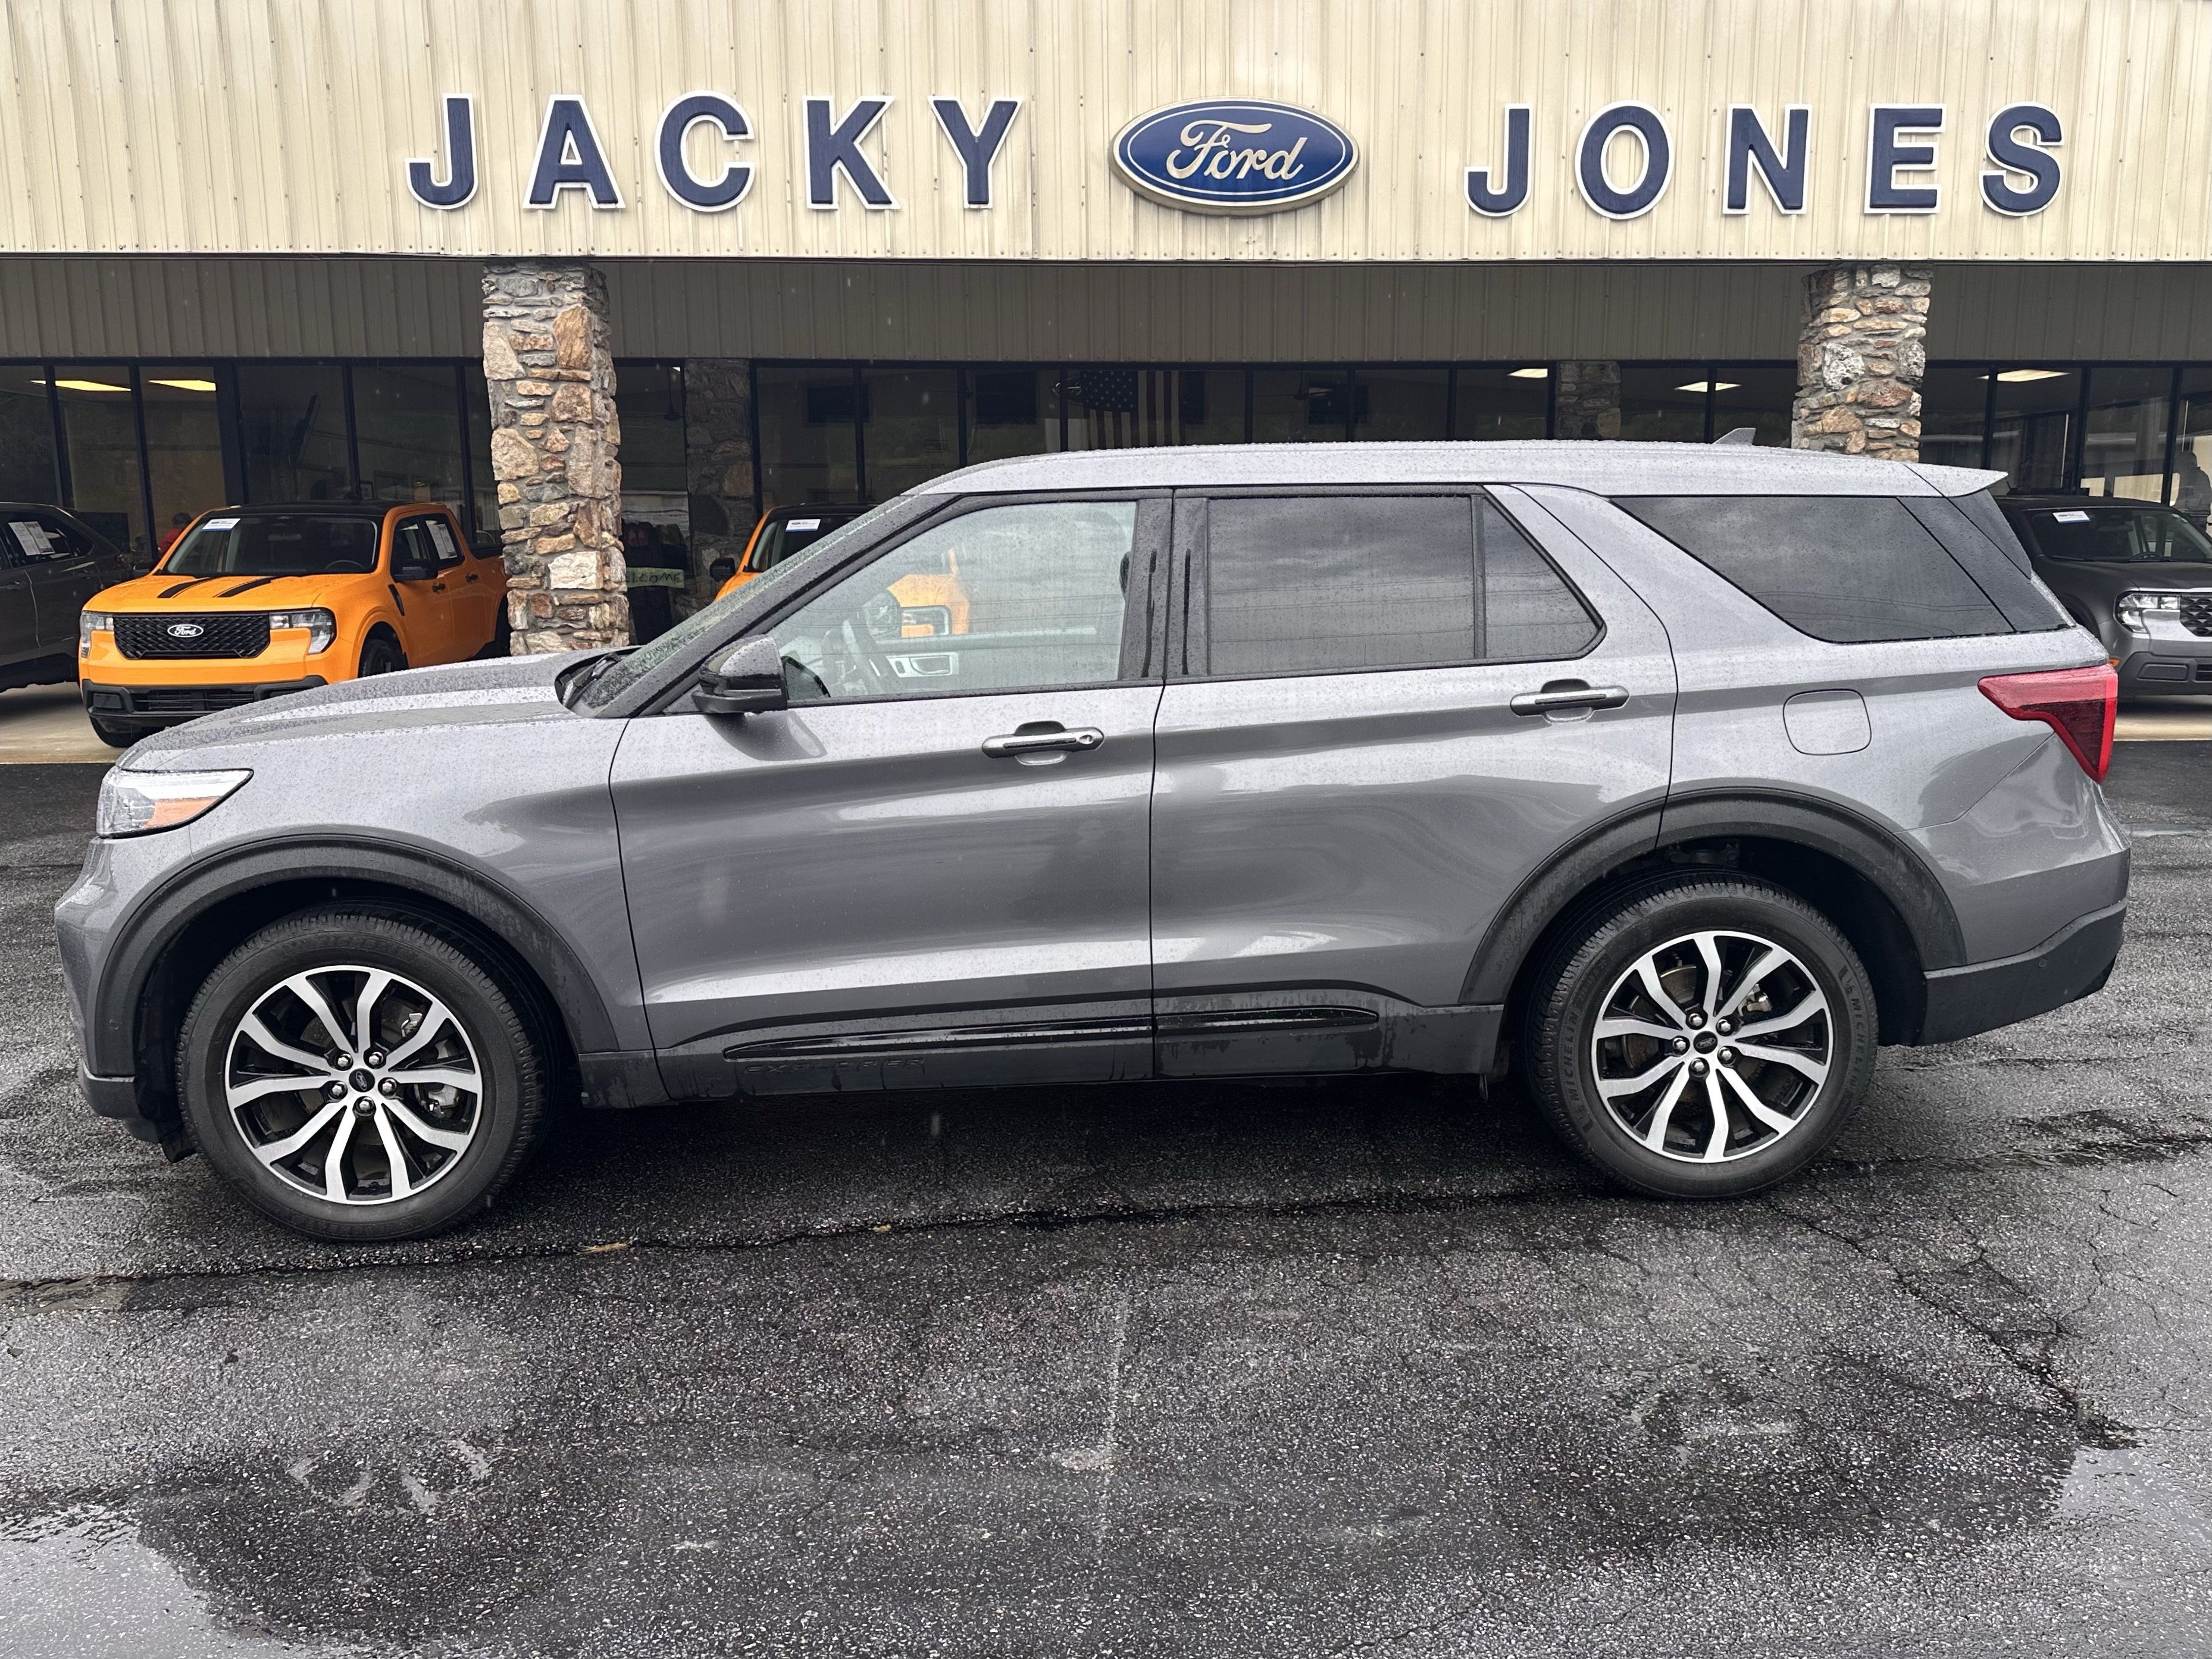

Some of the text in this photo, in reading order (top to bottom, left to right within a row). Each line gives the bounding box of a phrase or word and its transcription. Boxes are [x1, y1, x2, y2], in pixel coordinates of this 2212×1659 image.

[405, 90, 1022, 211] JACKY
[1166, 120, 1308, 180] Ford
[1464, 101, 2064, 219] JONES
[174, 626, 196, 636] Ford
[1562, 1012, 1580, 1101] MICHELIN
[1849, 998, 1864, 1087] MICHELIN
